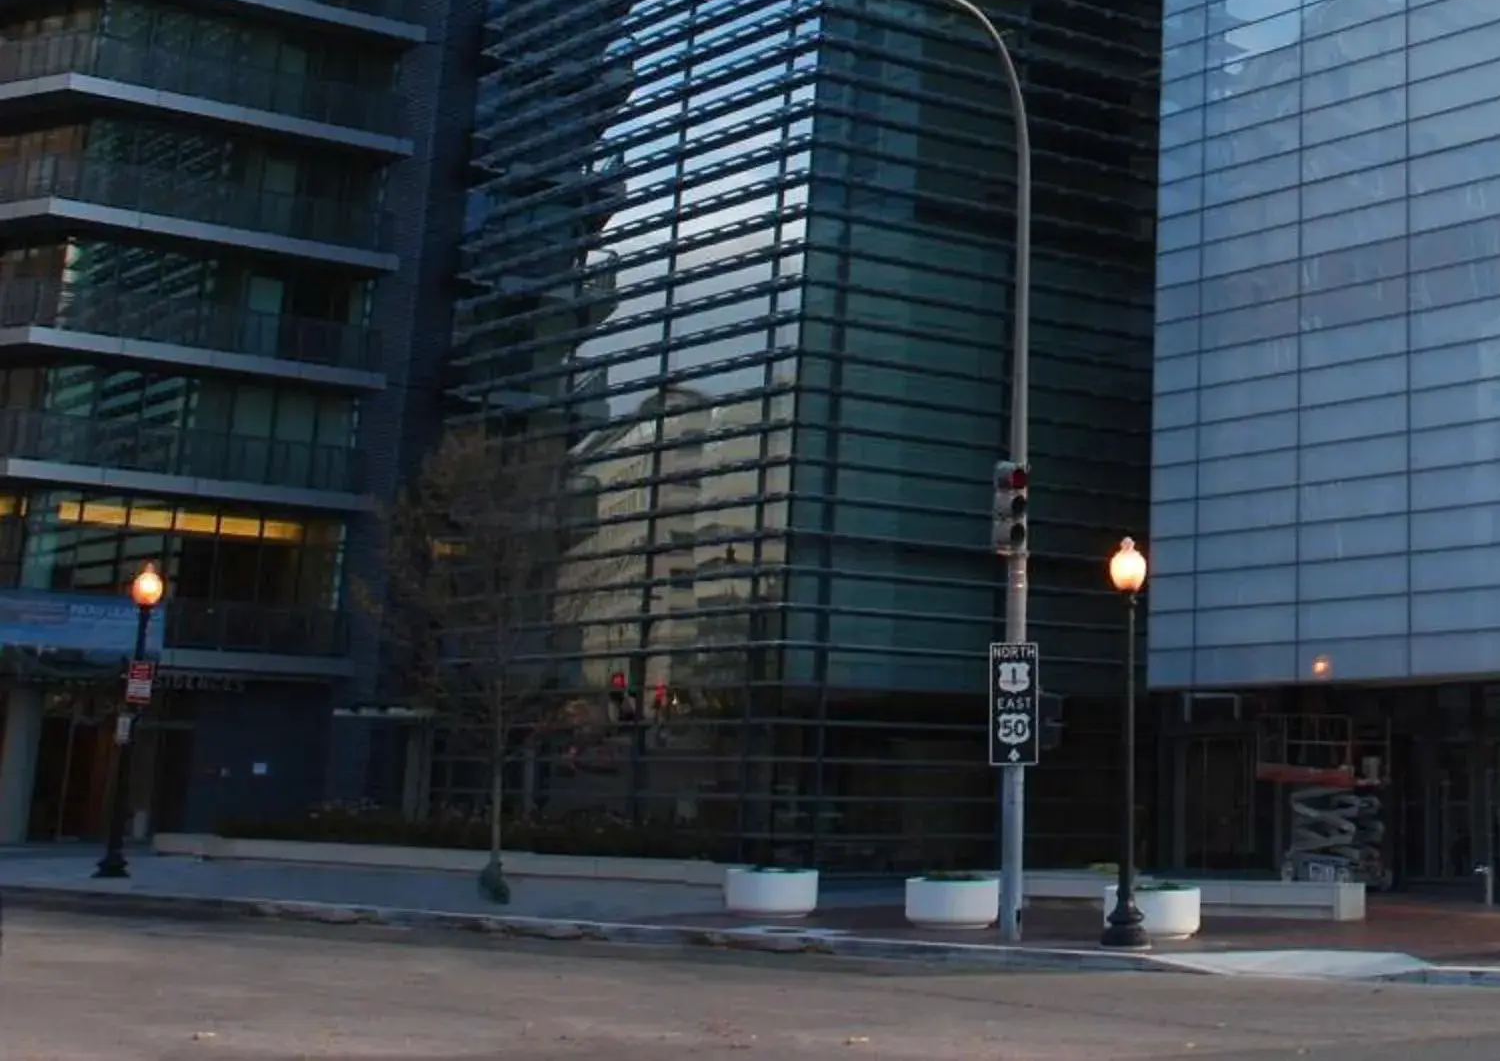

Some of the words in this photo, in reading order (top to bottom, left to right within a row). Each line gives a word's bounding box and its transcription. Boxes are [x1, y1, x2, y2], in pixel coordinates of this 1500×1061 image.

[993, 647, 1036, 658] NORTH
[998, 698, 1032, 709] EAST
[1002, 719, 1027, 738] 50
